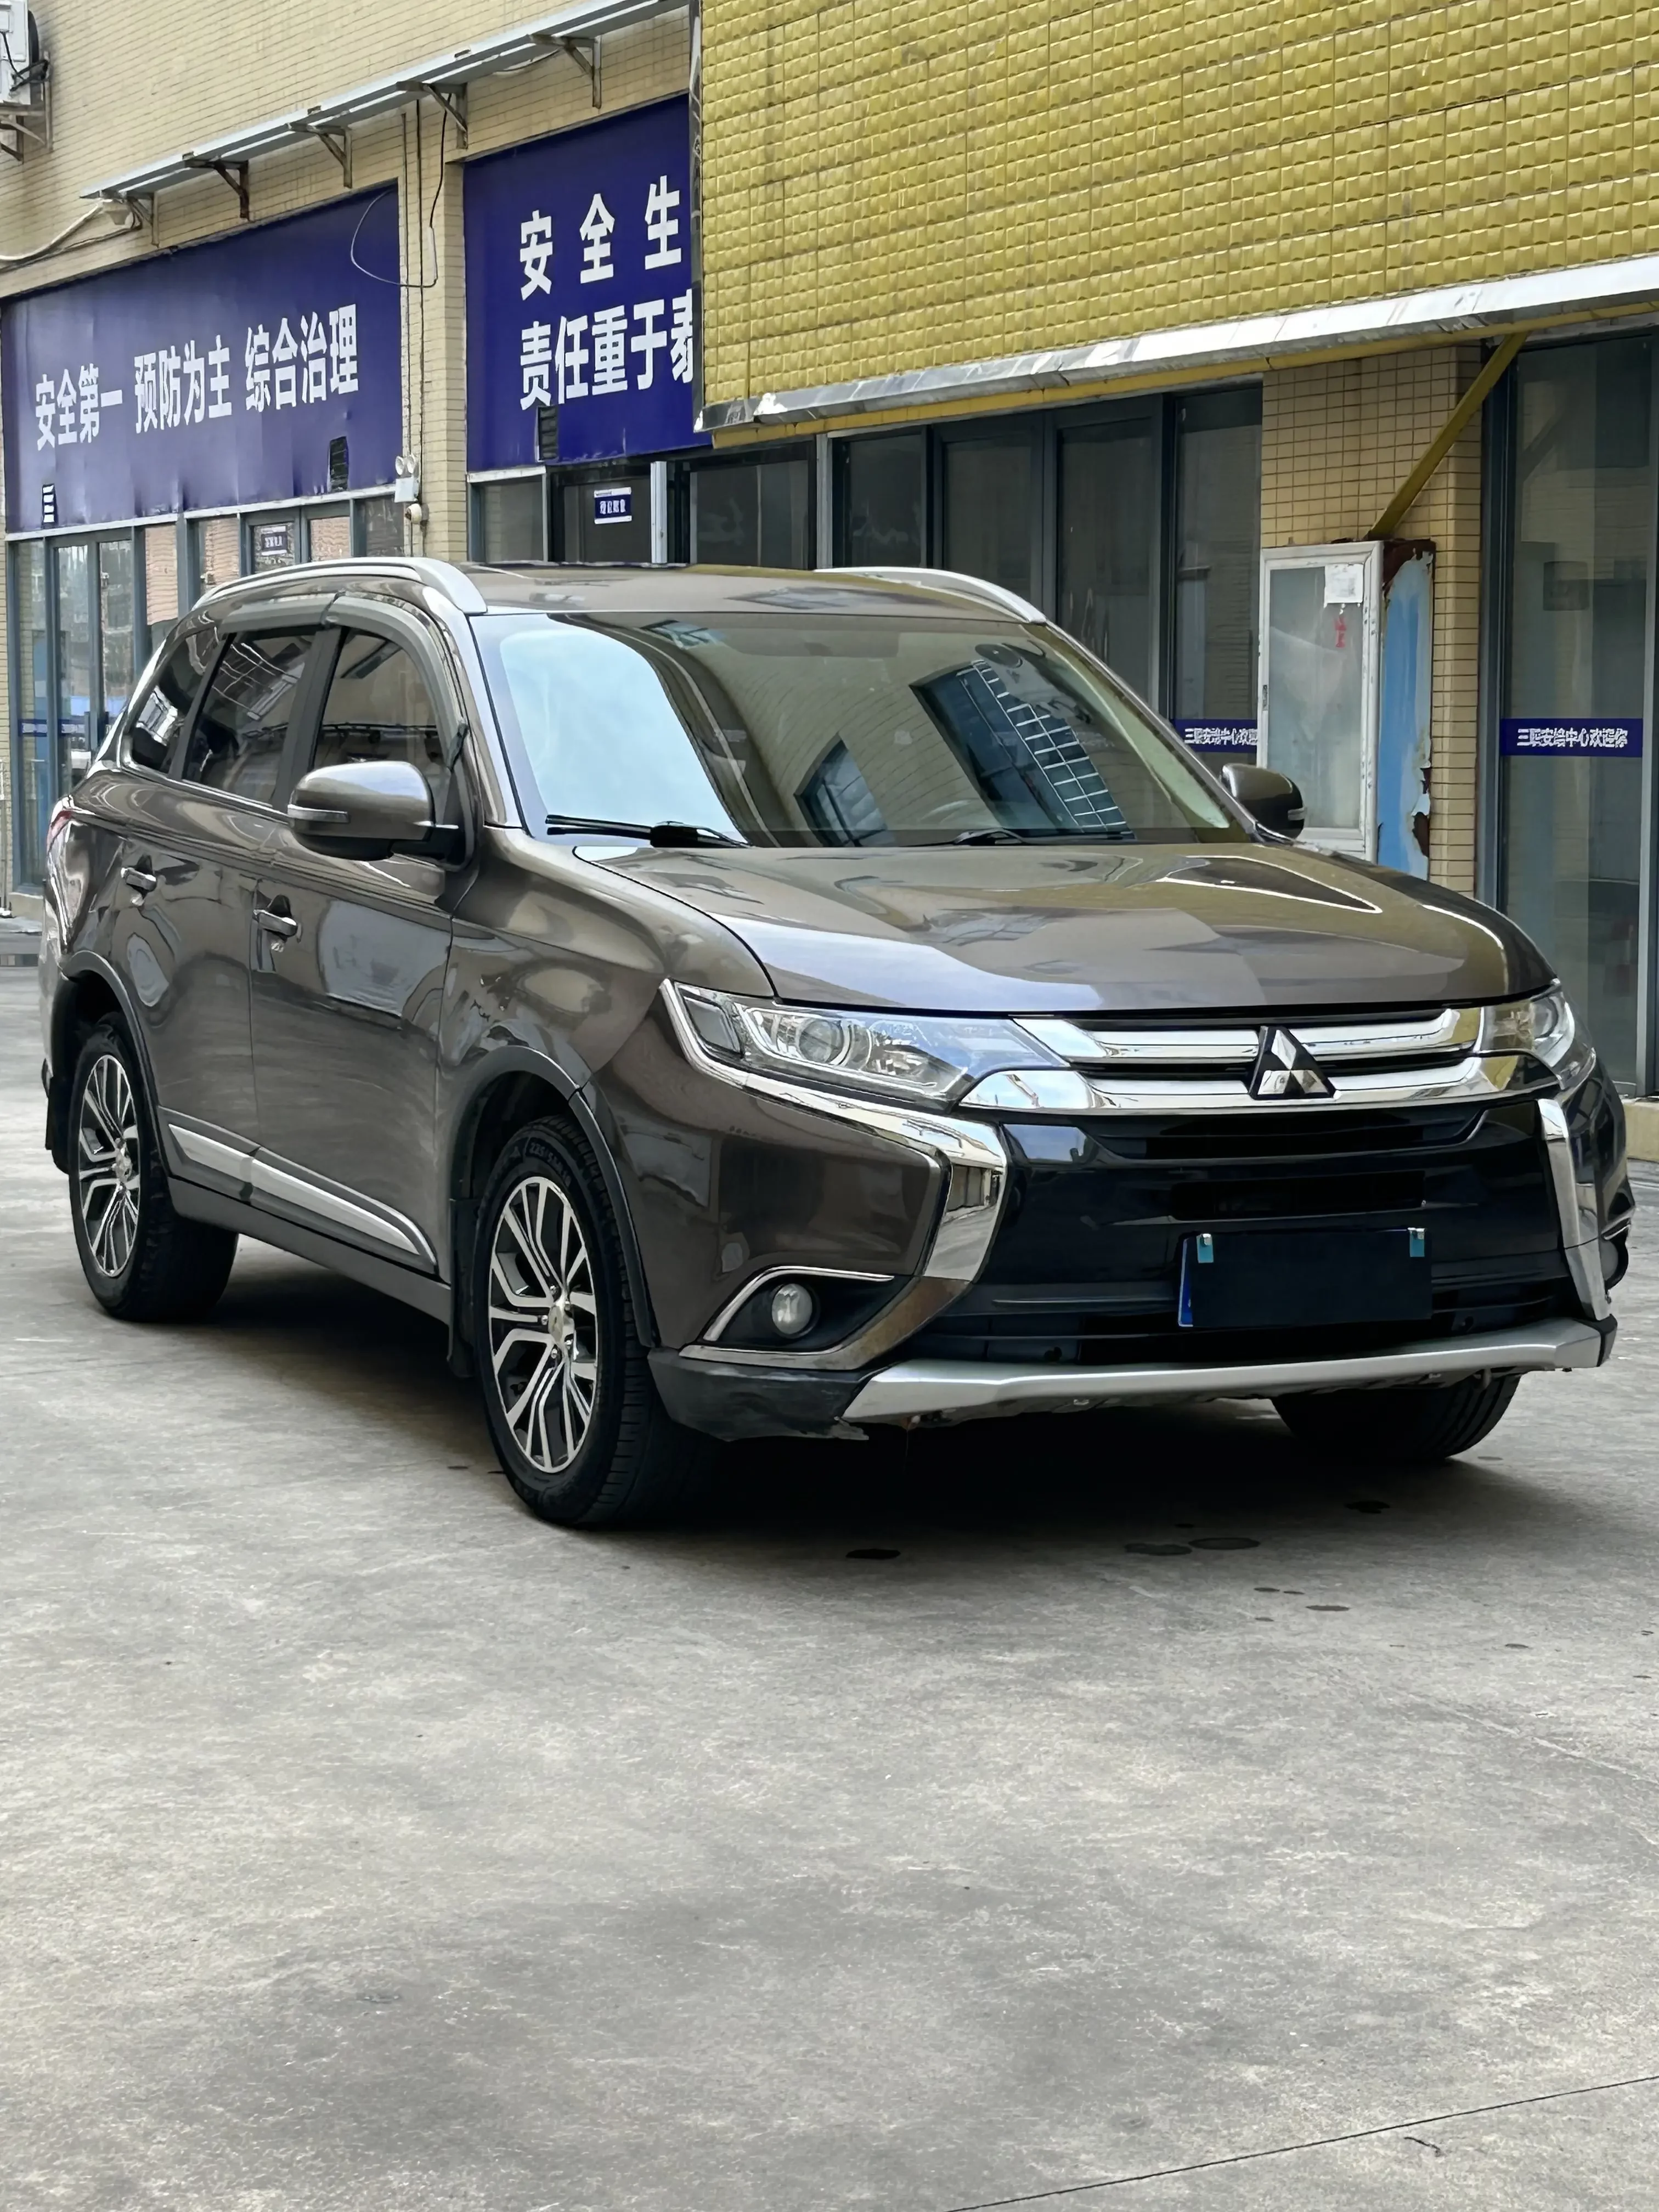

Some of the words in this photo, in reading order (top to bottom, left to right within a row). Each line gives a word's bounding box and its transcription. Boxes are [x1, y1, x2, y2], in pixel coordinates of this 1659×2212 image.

[520, 176, 681, 301] 安全生
[36, 363, 123, 451] 安全第一
[134, 335, 232, 434] 预防为主
[245, 304, 358, 413] 综合治理
